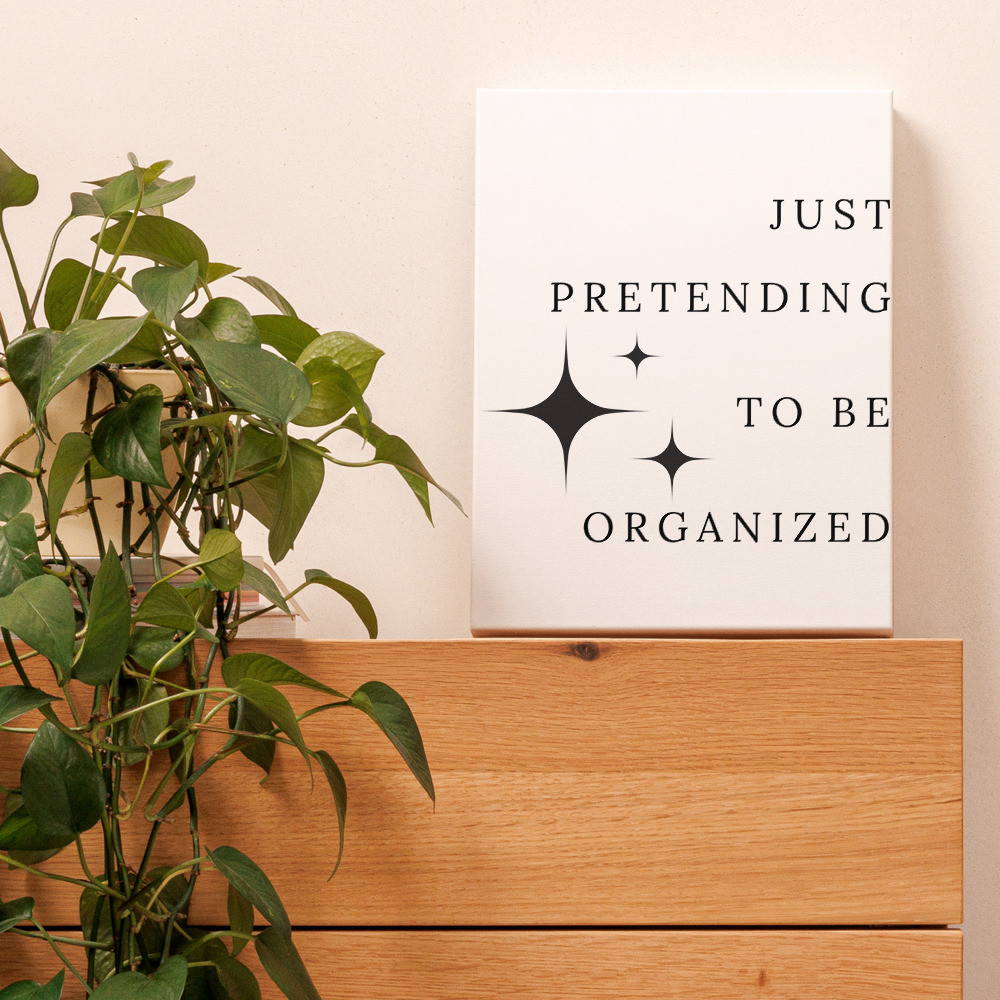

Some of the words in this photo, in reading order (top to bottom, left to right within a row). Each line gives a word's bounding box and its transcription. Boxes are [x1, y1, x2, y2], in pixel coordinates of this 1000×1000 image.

[769, 198, 891, 230] JUST
[550, 281, 891, 313] PRETENDING
[736, 396, 803, 428] TO
[832, 397, 890, 428] BE
[583, 511, 890, 543] ORGANIZED
